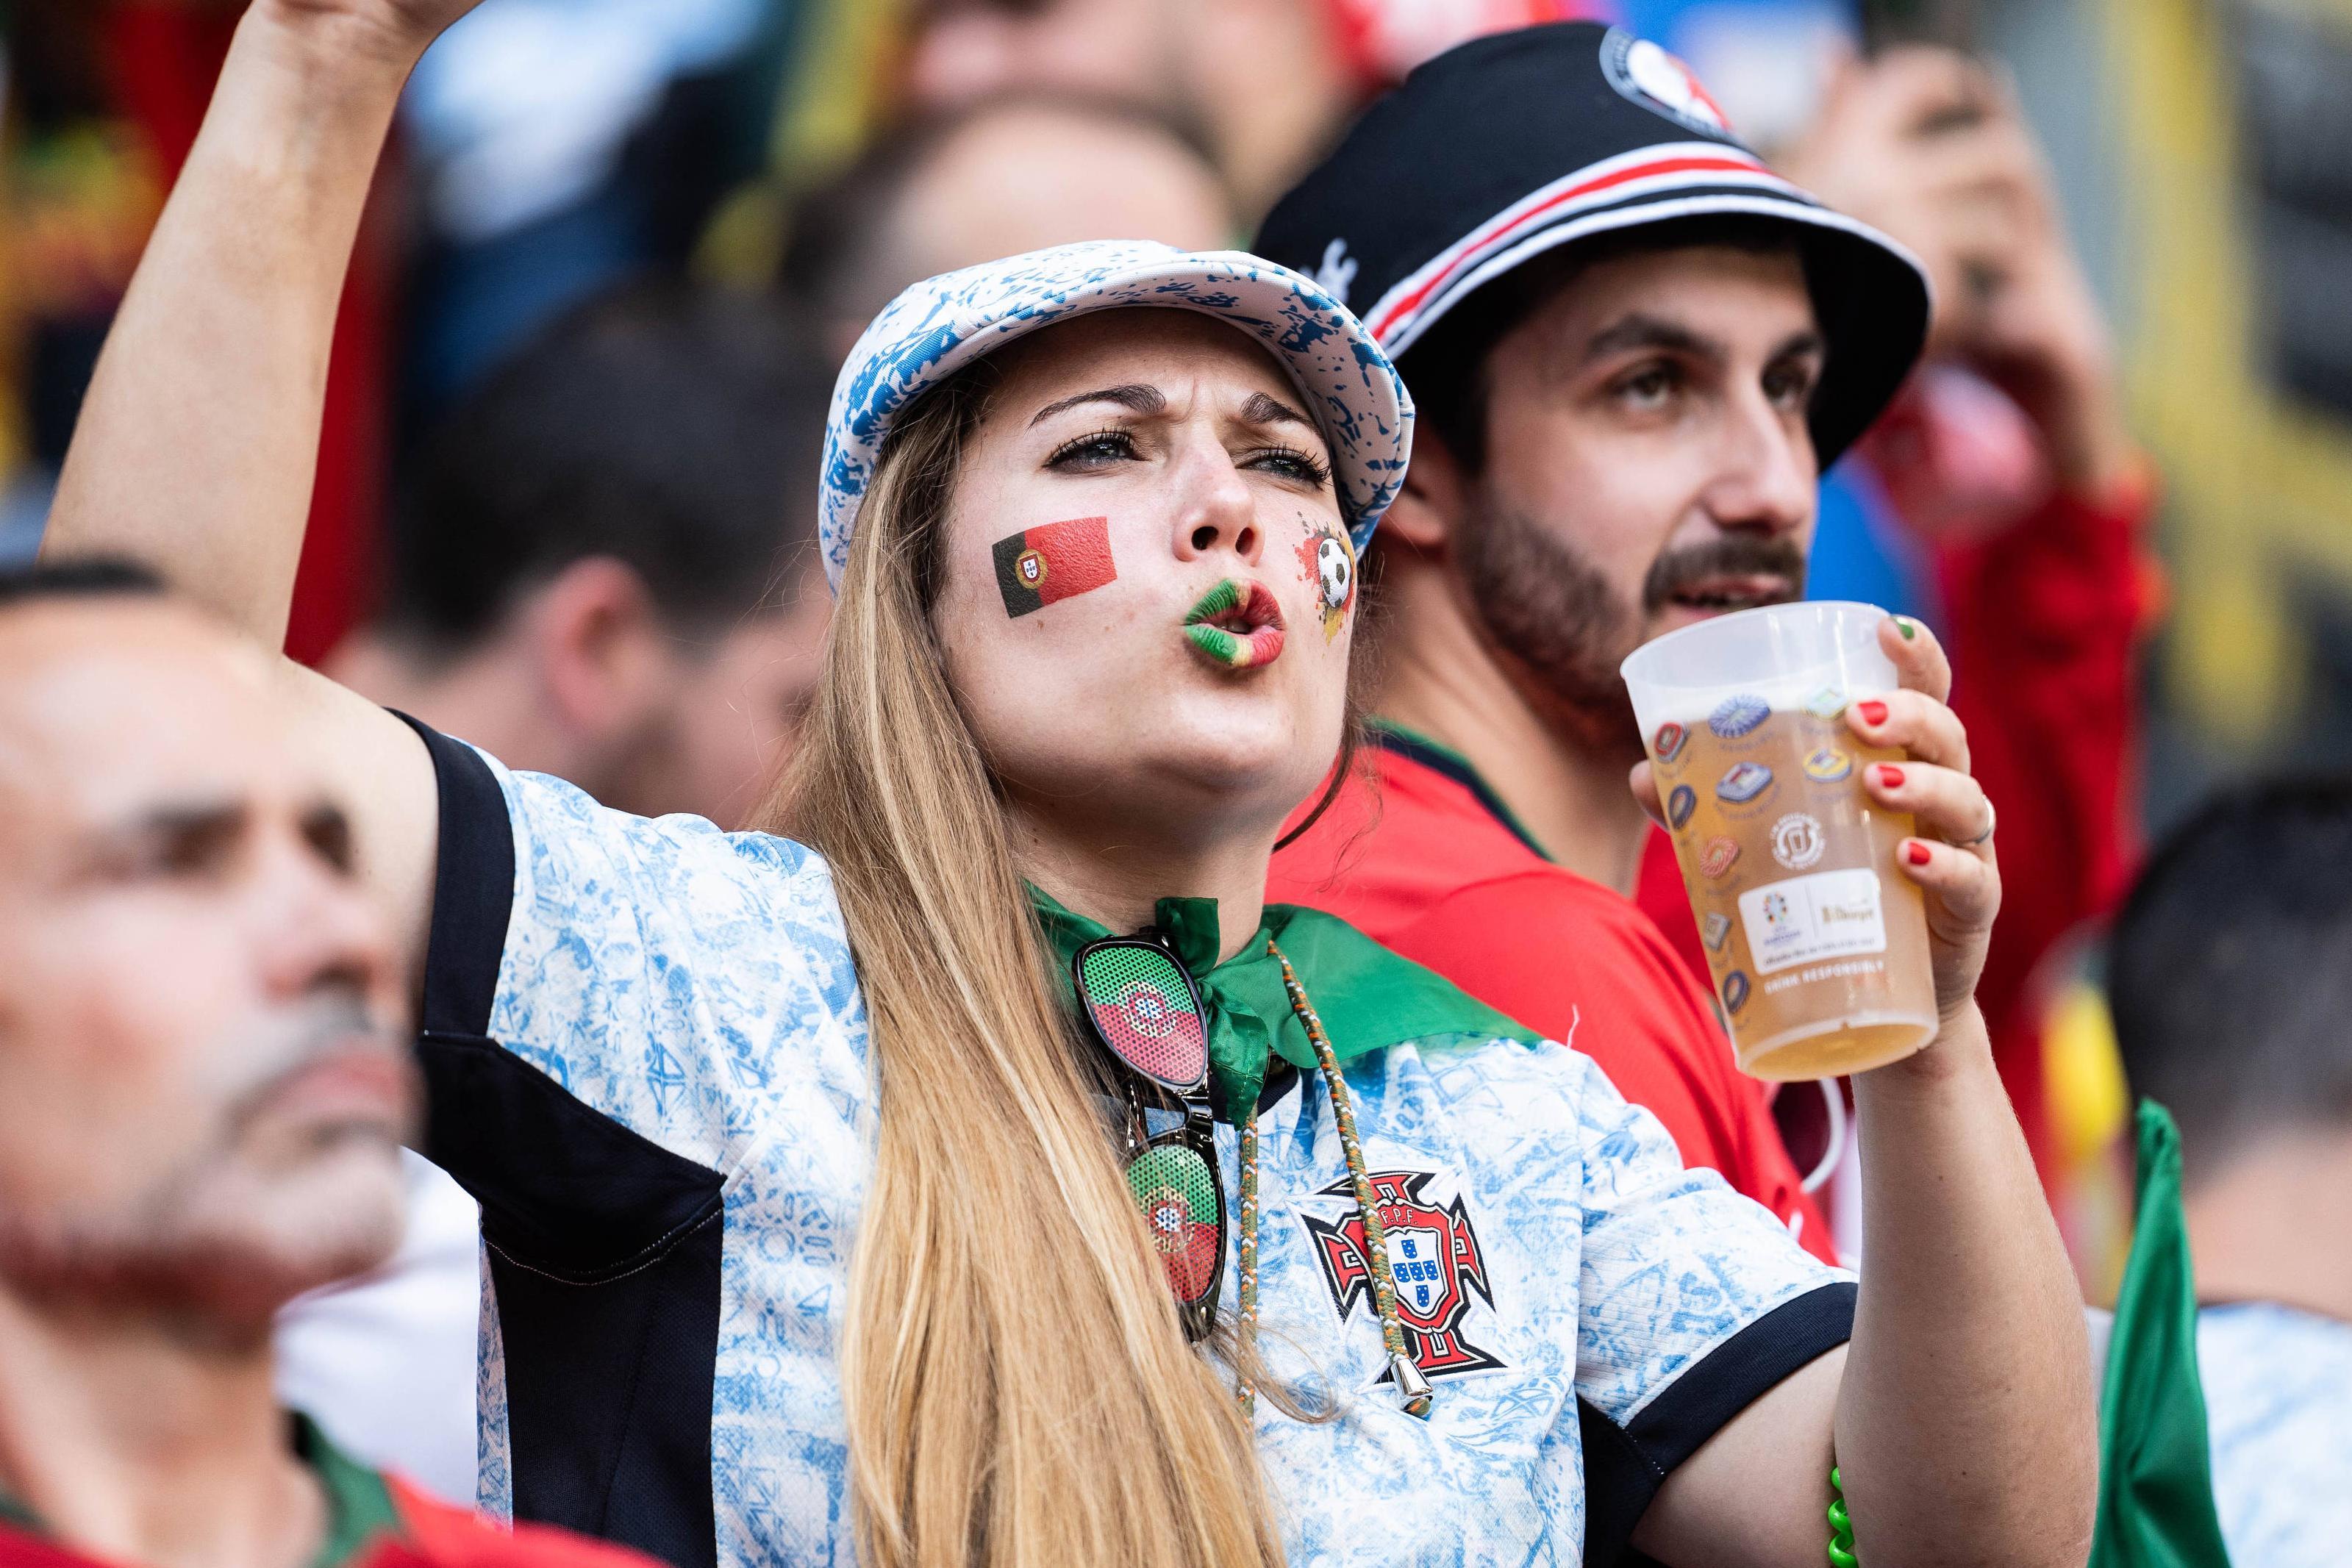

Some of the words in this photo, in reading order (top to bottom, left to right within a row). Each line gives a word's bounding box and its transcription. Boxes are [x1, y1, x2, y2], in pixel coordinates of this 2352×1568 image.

[1765, 973, 1800, 995] DRINK
[1802, 959, 1884, 984] RESPONSIBLY
[1380, 1208, 1418, 1225] F.P.F.
